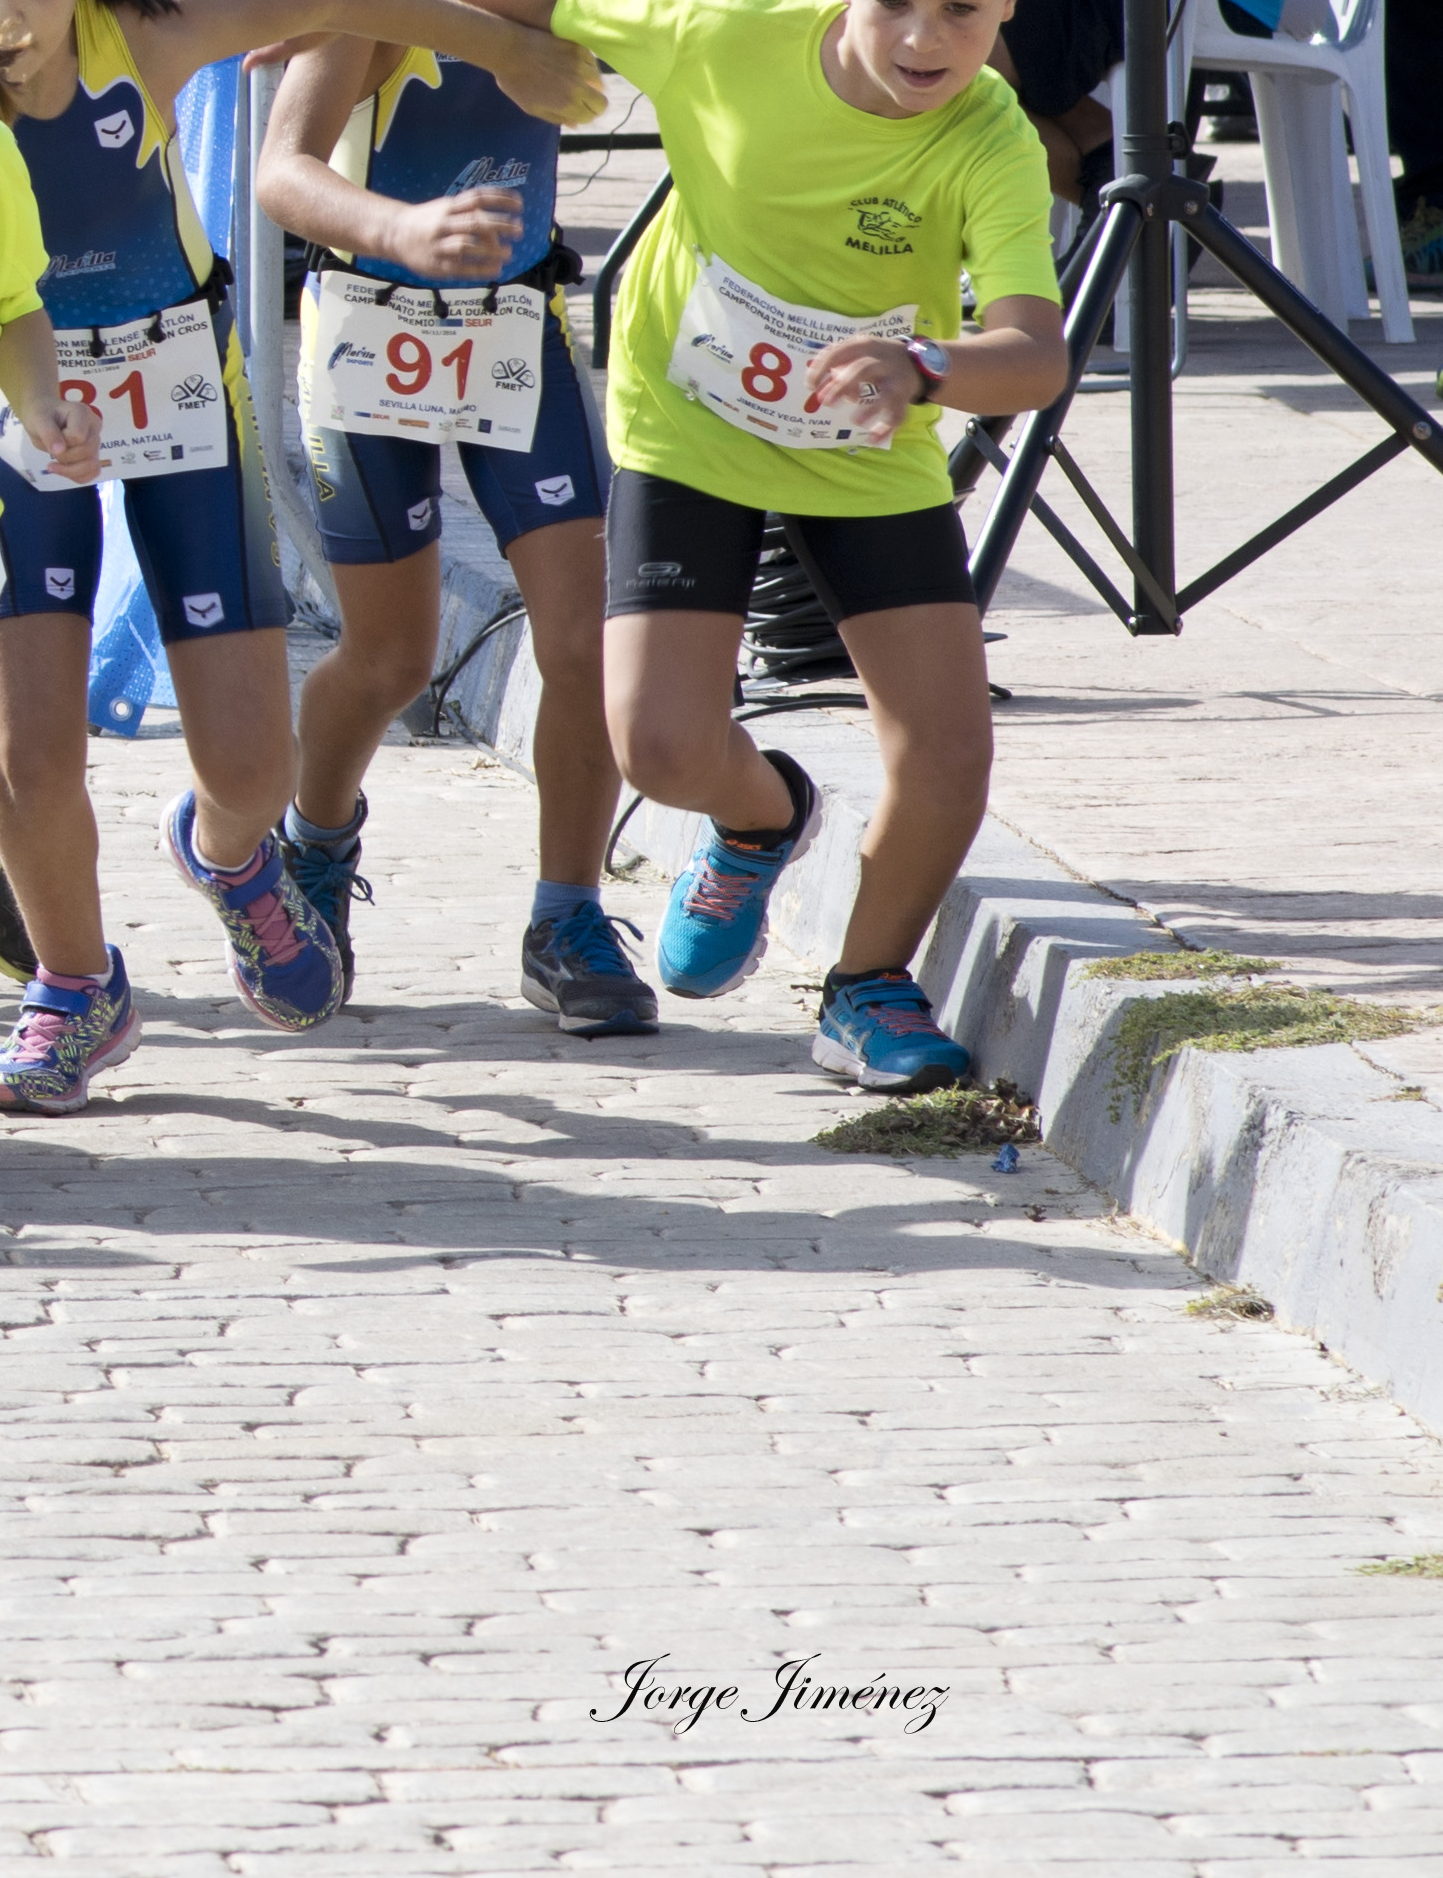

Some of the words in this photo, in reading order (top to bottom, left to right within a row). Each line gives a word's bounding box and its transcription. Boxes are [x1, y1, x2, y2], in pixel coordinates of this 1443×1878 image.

[850, 197, 879, 207] CLUB
[882, 197, 923, 223] ATLÉTICO
[845, 236, 914, 255] MELILLA
[516, 307, 540, 321] CROS
[718, 286, 785, 329] CAMPEONATO
[787, 324, 834, 343] MELILLA
[886, 325, 912, 338] CROS
[722, 276, 785, 318] FEDERACIÓN
[787, 314, 856, 335] MELILLENSE
[178, 321, 208, 336] CROS
[398, 315, 435, 327] PREMIO
[465, 318, 493, 327] SEUR
[763, 324, 804, 344] PREMIO
[57, 359, 96, 368] PREMIO
[128, 348, 157, 362] SEUR
[386, 332, 473, 401] 91
[495, 381, 524, 392] FMET
[178, 400, 207, 411] FMET
[379, 399, 417, 411] SEVILLA
[736, 396, 775, 417] JIMENEZ
[99, 439, 127, 449] AURA,
[131, 433, 173, 445] NATALIA
